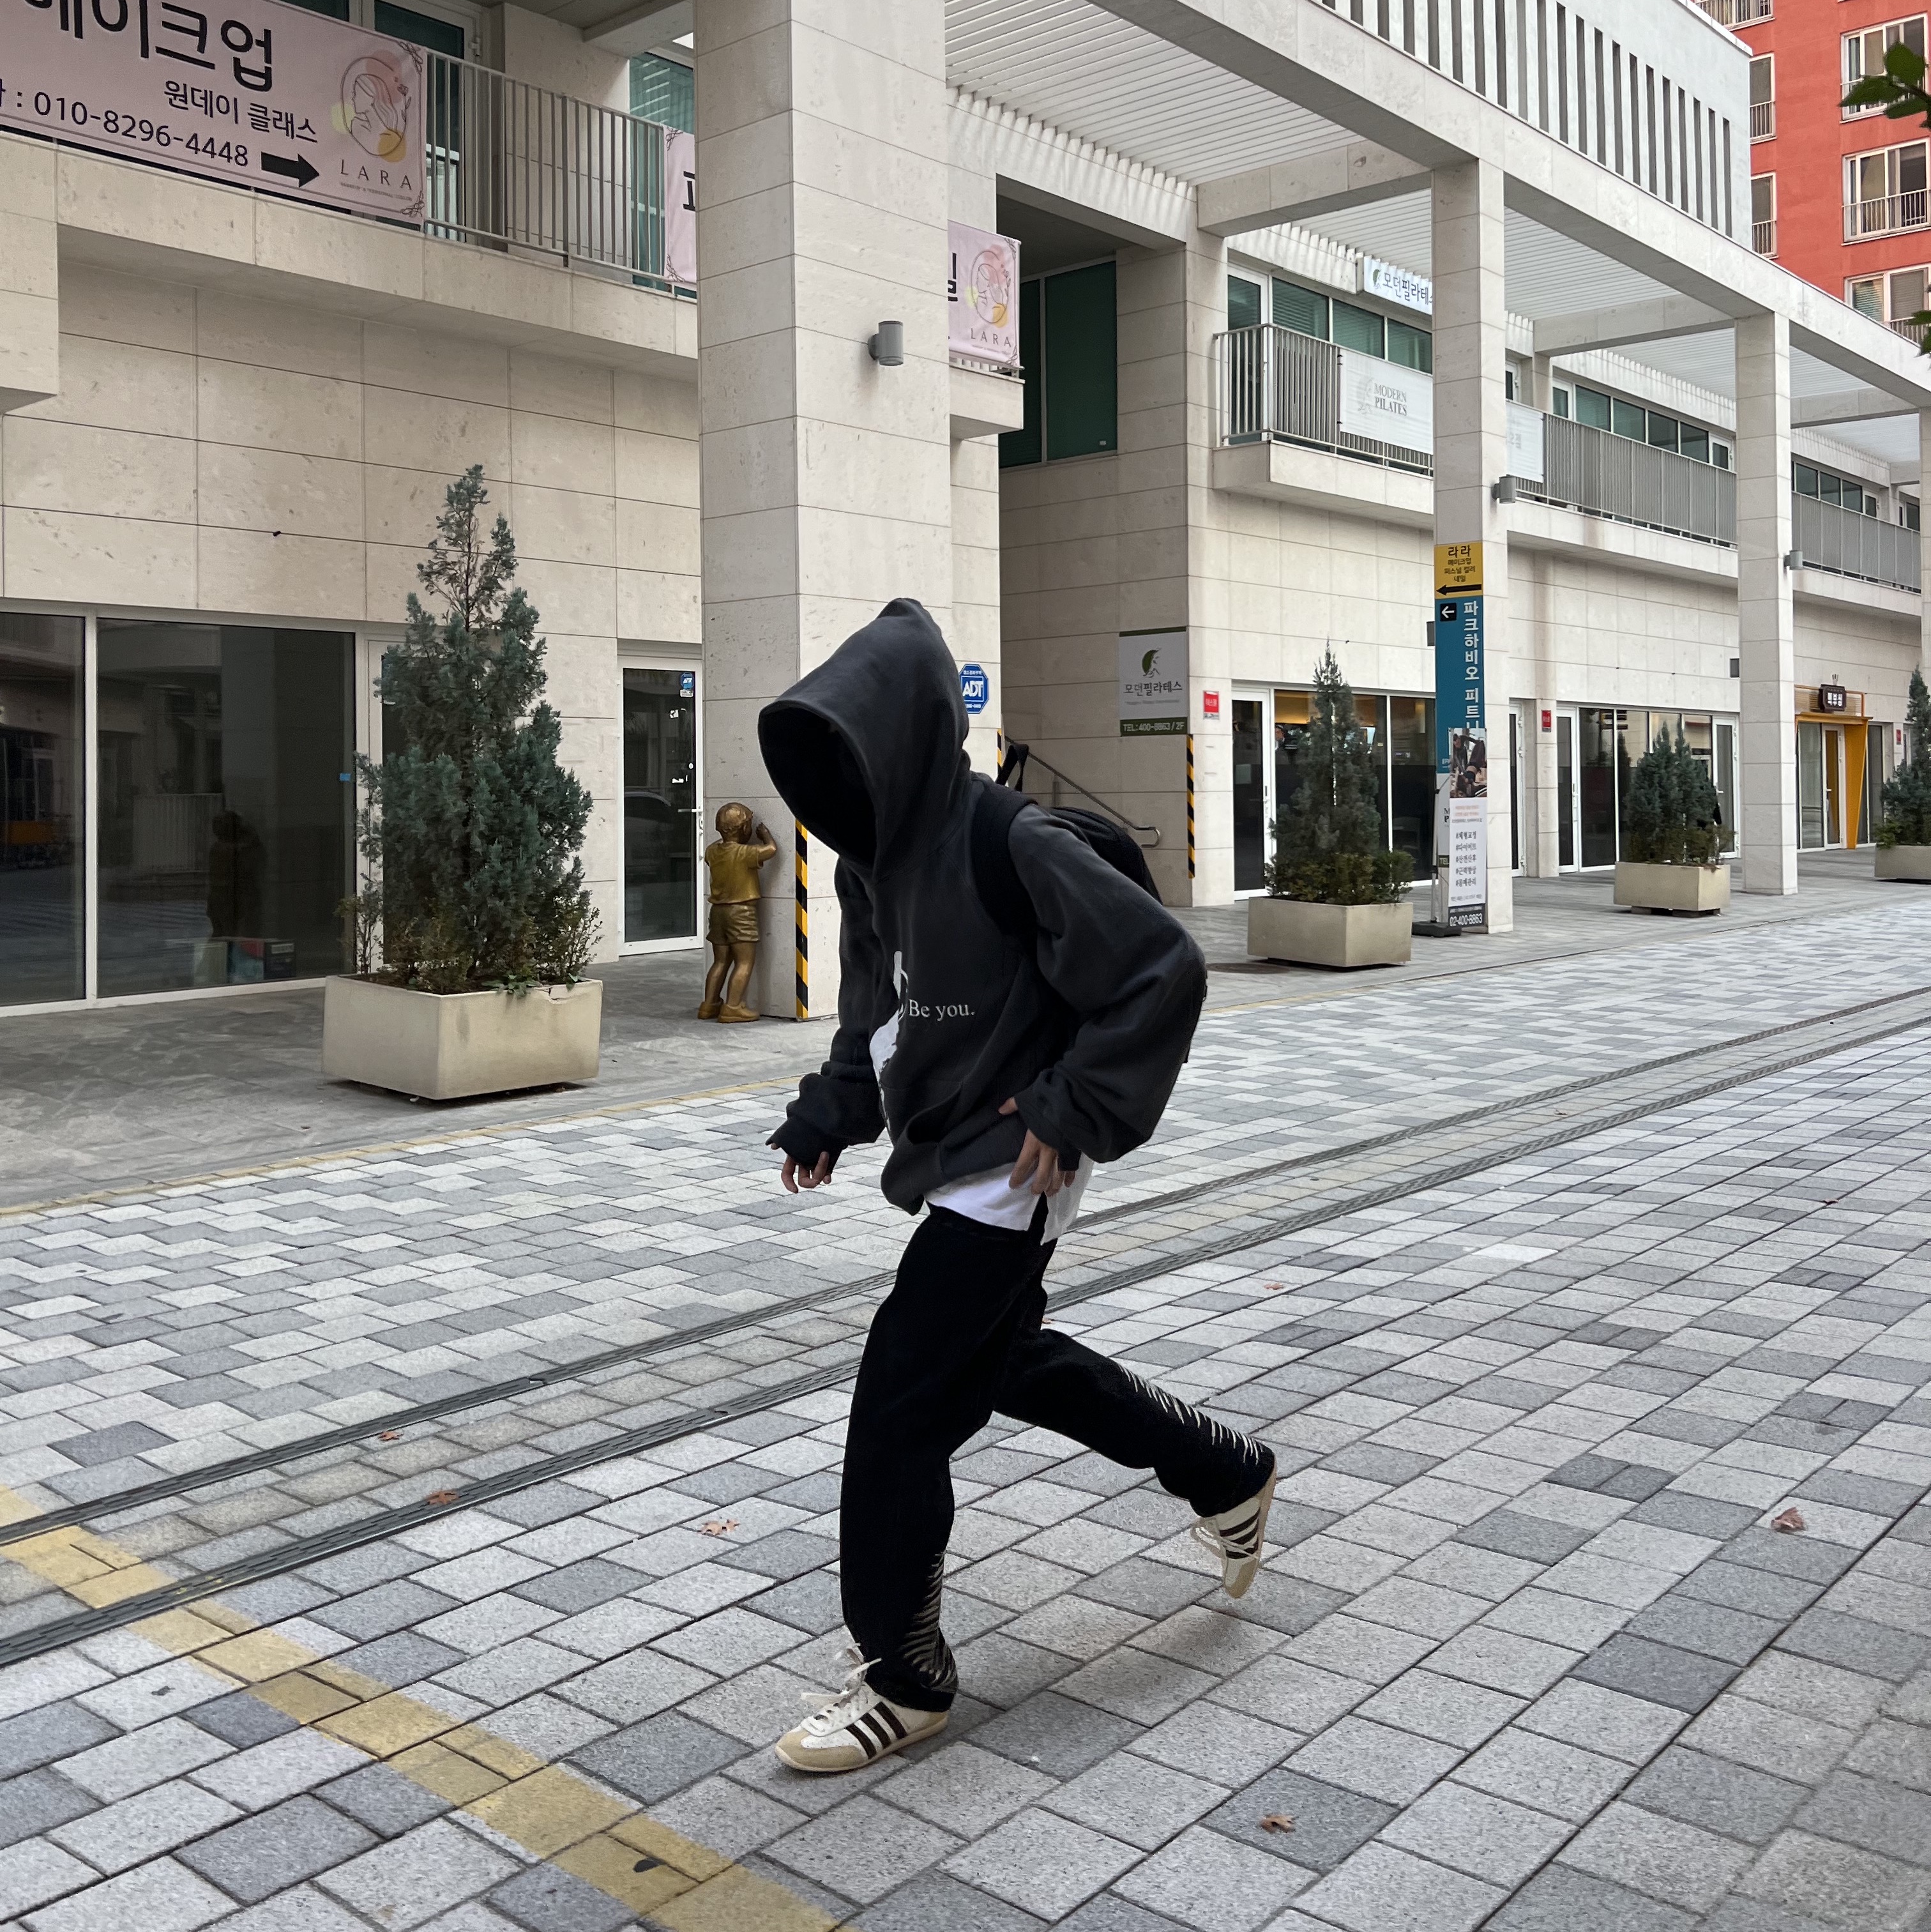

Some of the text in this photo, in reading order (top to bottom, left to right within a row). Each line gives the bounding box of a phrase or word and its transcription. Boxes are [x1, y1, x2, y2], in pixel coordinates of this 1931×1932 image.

[164, 80, 318, 142] 원데이 클래스
[34, 91, 248, 167] 010-8296-4448
[340, 159, 412, 190] LARA
[971, 328, 1011, 347] LARA
[1374, 383, 1407, 402] MODERN
[1375, 396, 1407, 416] PILATES
[1448, 544, 1471, 558] 라라
[1464, 600, 1479, 680] 파크하비오
[962, 680, 983, 697] ADT
[1123, 681, 1183, 696] 모던필라테스
[909, 998, 975, 1021] Be you.
